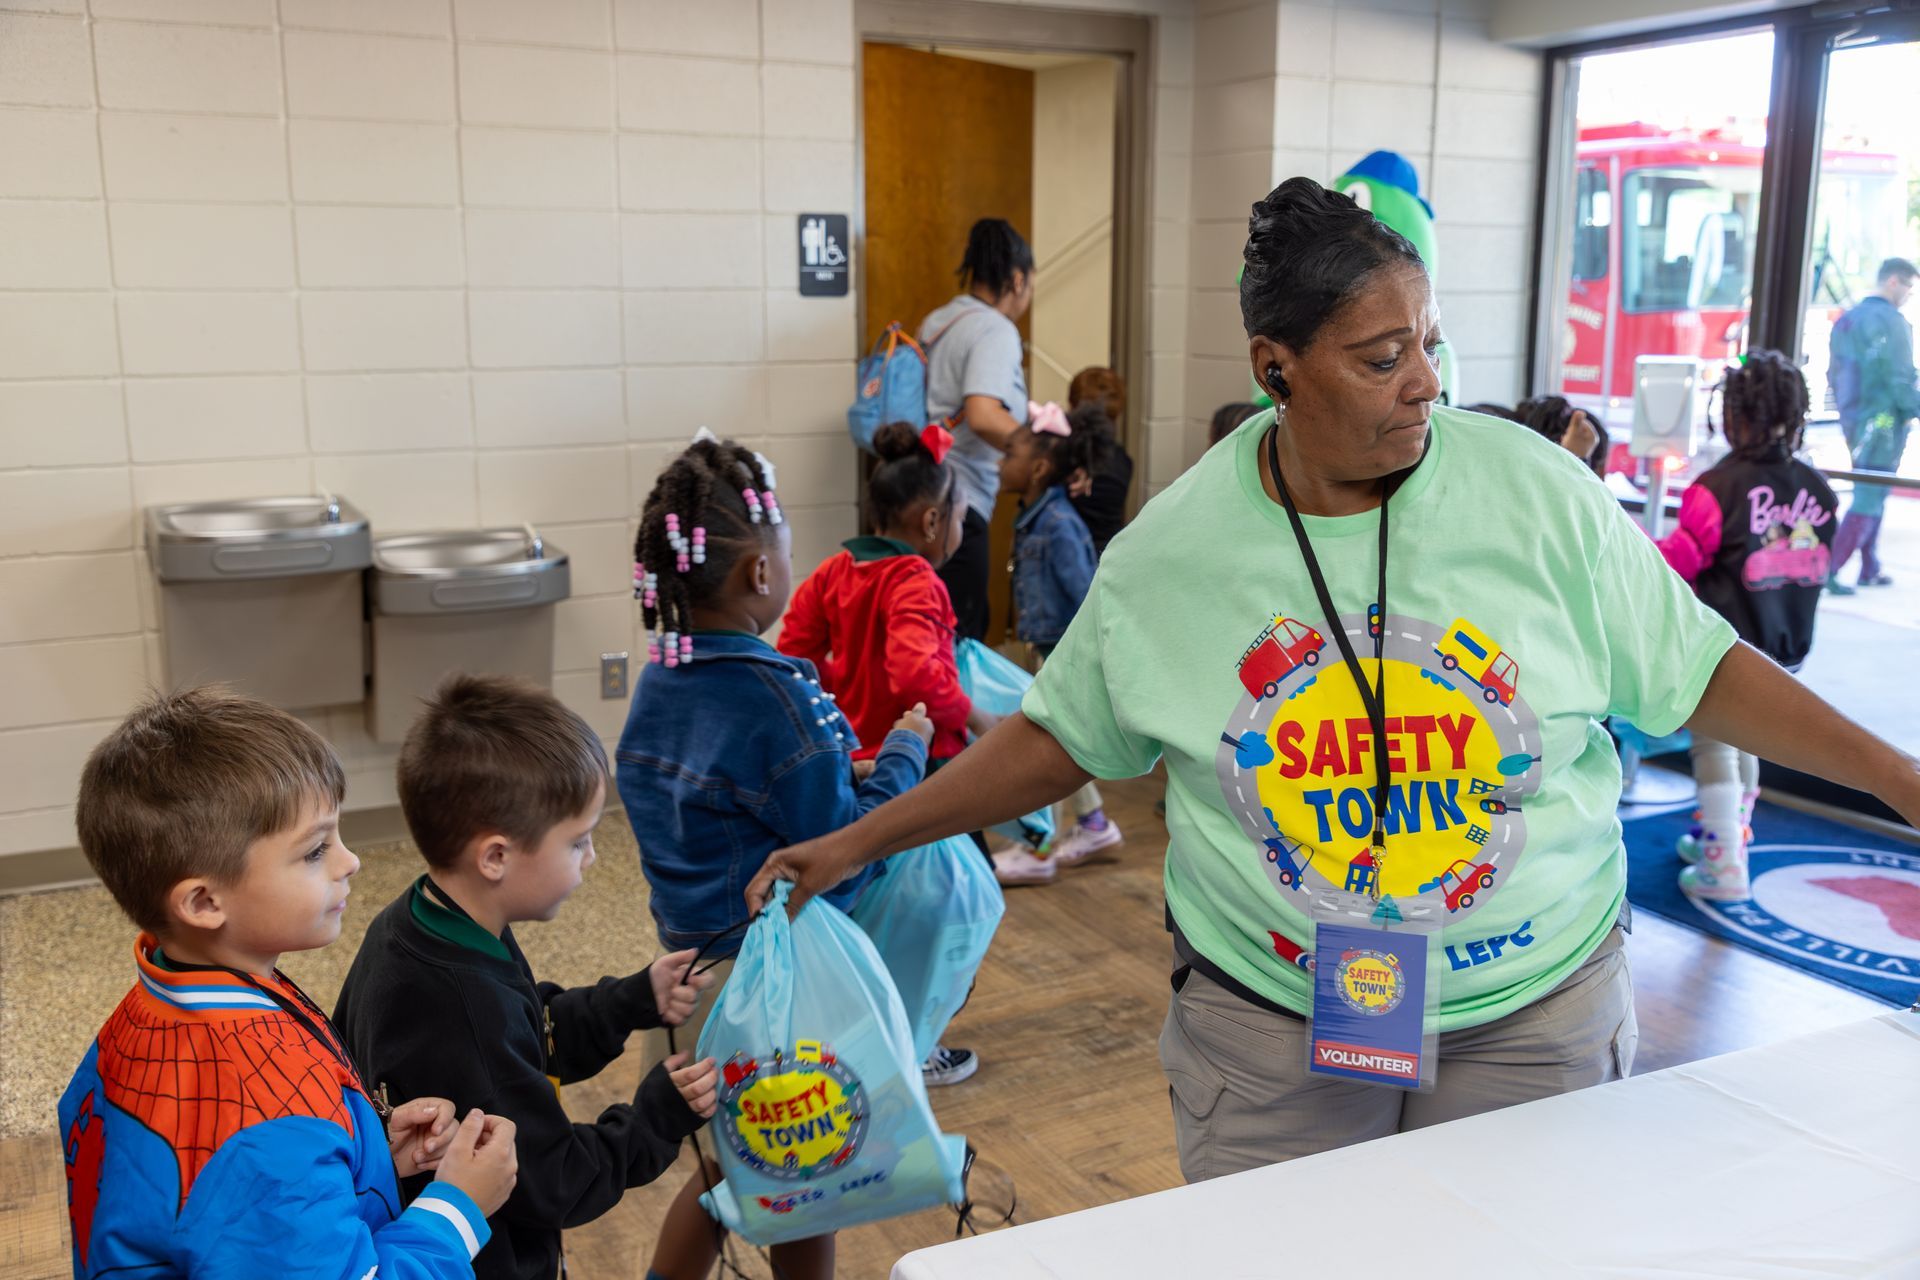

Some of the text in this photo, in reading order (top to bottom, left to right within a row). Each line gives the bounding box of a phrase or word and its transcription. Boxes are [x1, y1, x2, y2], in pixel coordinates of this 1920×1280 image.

[1747, 485, 1831, 535] Barbie
[1276, 713, 1476, 779] SAFETY
[1303, 778, 1467, 843] TOWN
[1445, 920, 1535, 971] LEPC
[1349, 967, 1390, 983] SAFETY
[1353, 980, 1386, 995] TOWN
[1319, 1047, 1413, 1074] VOLUNTEER
[742, 1080, 829, 1125] SAFETY
[759, 1111, 835, 1150] TOWN
